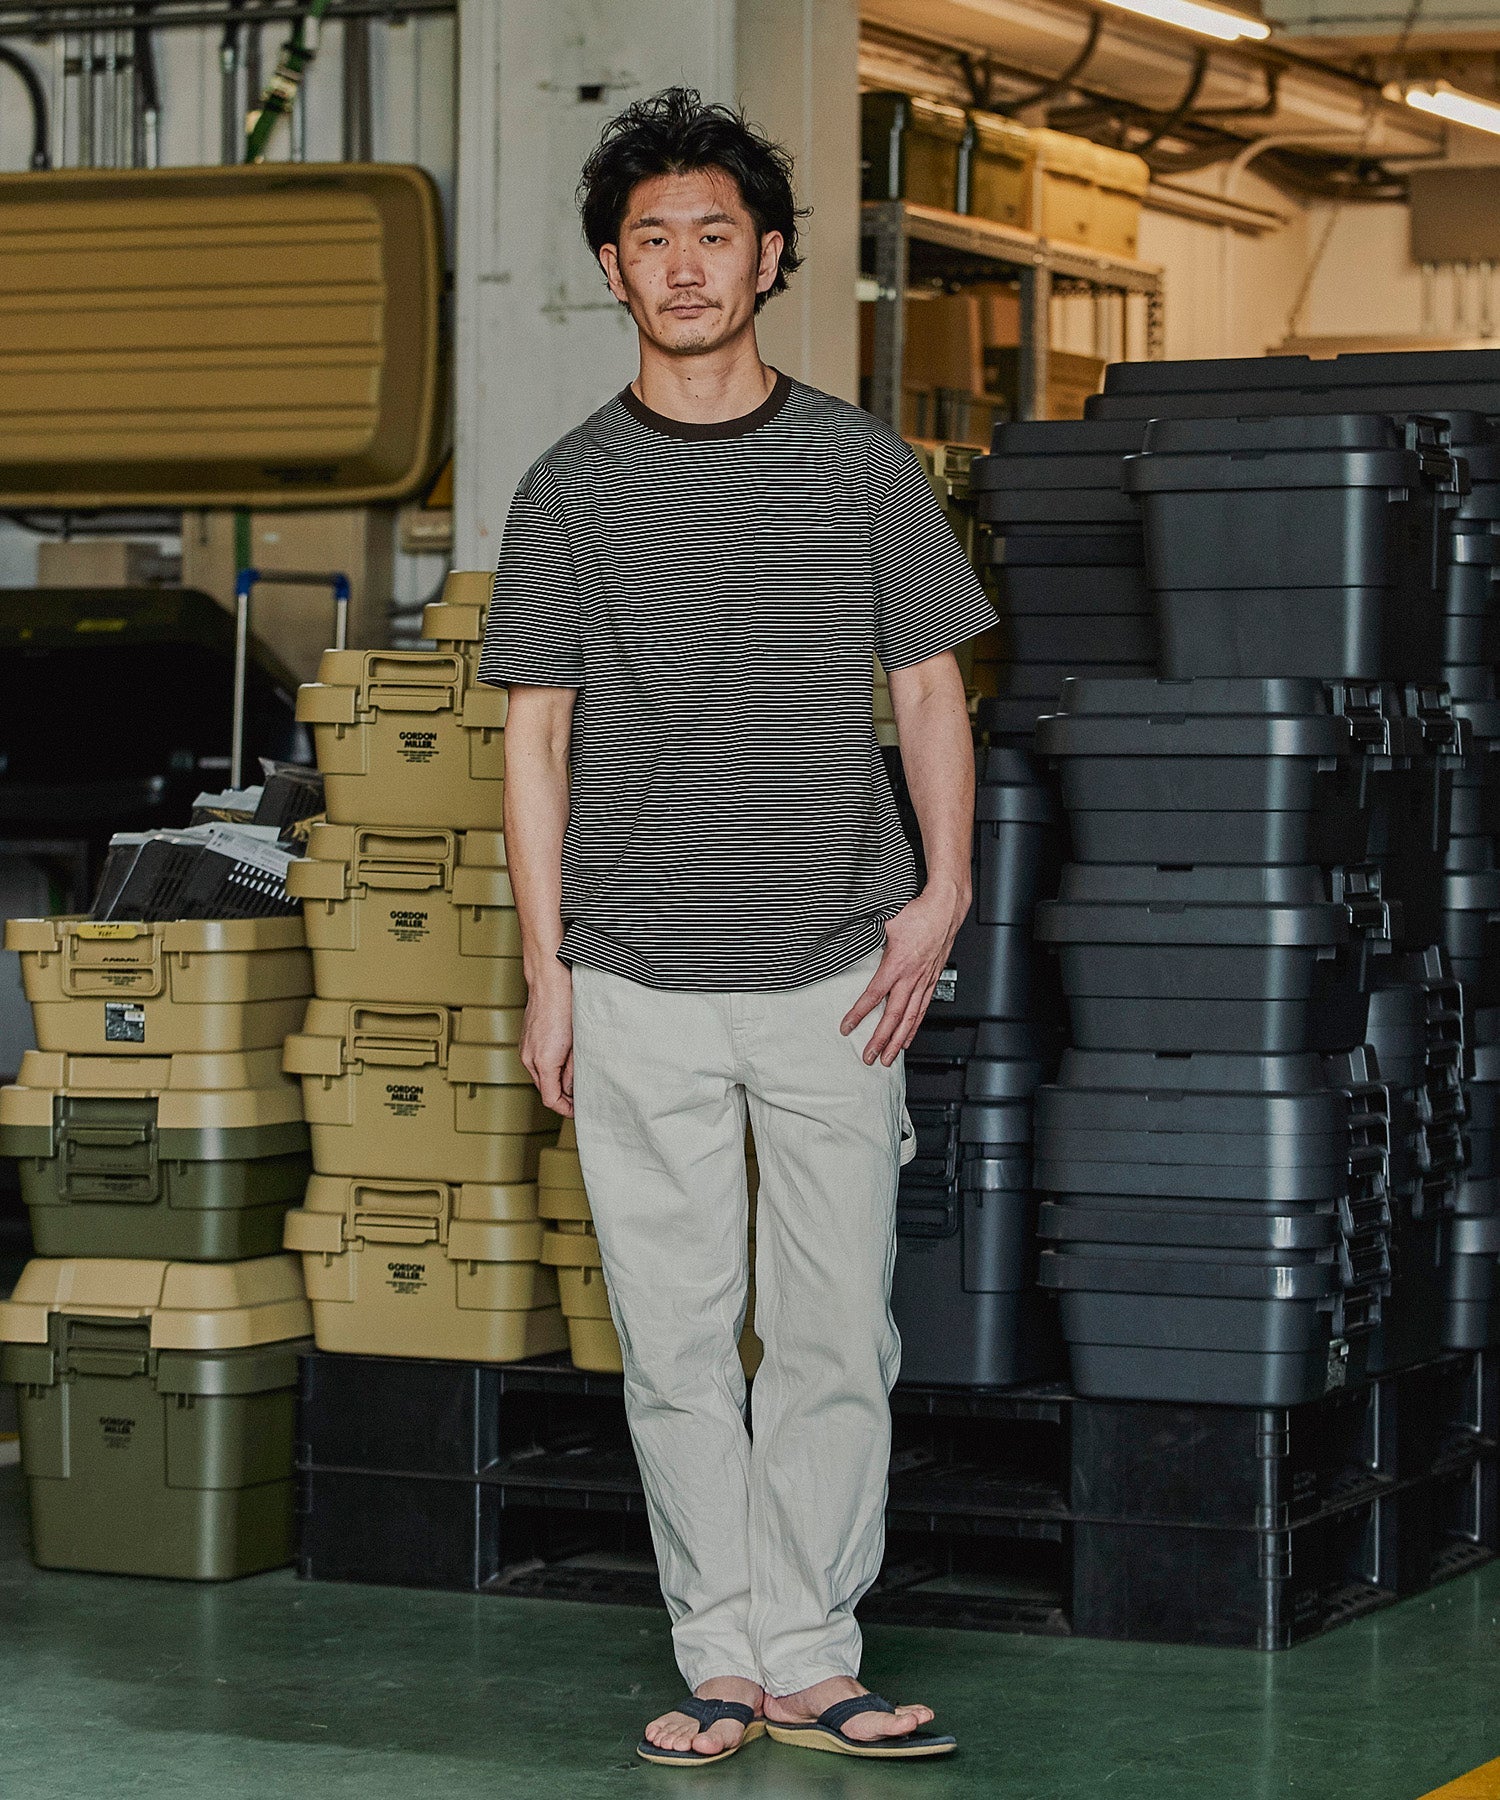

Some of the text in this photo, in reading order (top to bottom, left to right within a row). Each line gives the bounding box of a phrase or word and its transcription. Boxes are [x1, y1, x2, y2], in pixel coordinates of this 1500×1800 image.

[399, 731, 437, 740] GORDON
[390, 911, 428, 920] GORDON
[386, 1084, 424, 1094] GORDON
[388, 1262, 425, 1272] GORDON
